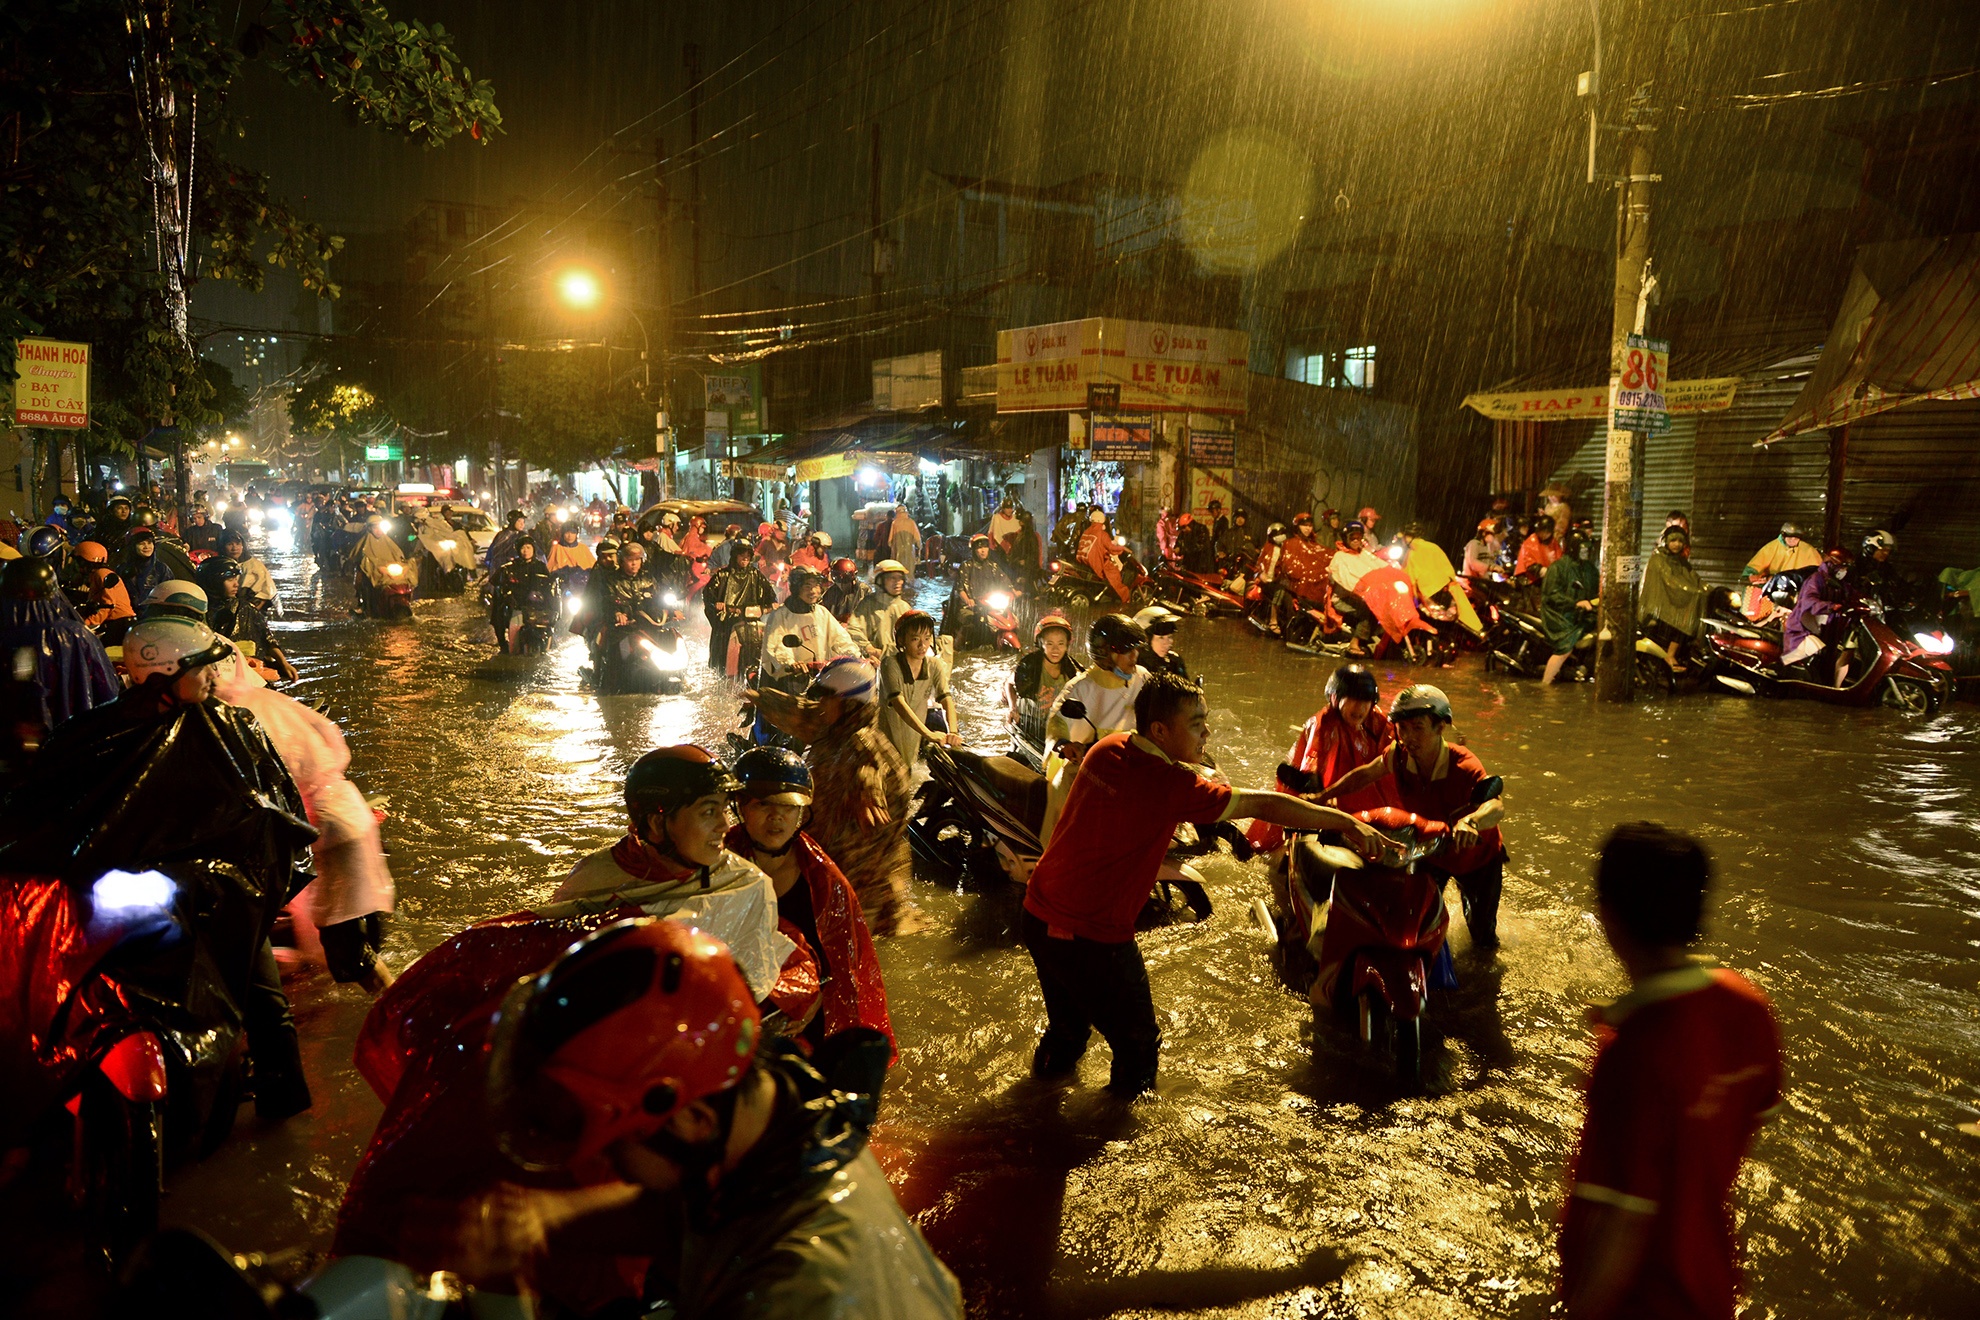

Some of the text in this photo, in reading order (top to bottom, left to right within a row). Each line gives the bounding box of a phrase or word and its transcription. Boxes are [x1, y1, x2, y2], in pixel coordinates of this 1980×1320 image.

[18, 344, 87, 365] THANH HOA
[29, 365, 76, 379] Chuyên
[1014, 364, 1030, 385] LÊ
[1132, 361, 1157, 382] LÊ
[1622, 349, 1658, 391] 86
[31, 382, 59, 394] BẠT
[31, 396, 84, 410] DÙ CÂY
[51, 413, 66, 422] ÂU
[70, 415, 86, 424] CƠ
